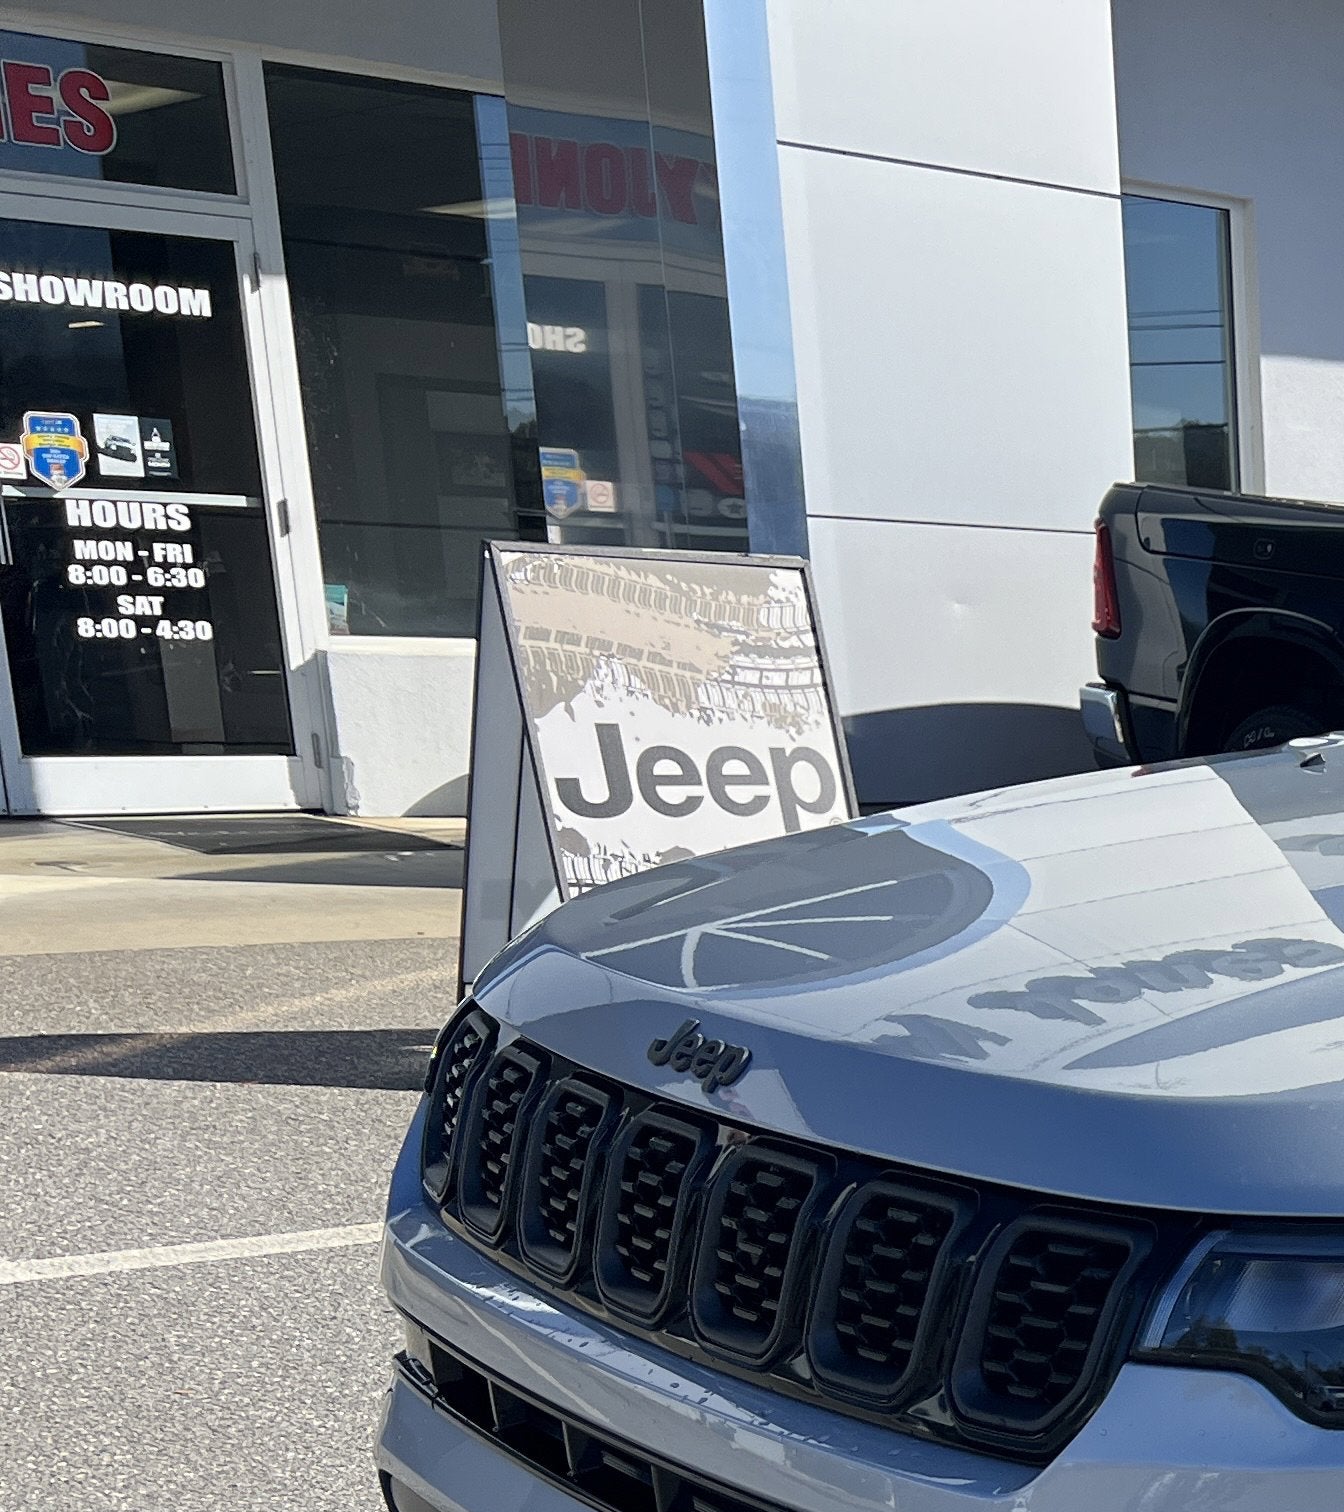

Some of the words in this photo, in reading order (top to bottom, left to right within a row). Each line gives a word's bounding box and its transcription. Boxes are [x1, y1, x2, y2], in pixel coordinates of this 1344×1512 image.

[0, 60, 117, 155] ES
[0, 270, 212, 318] SHOWROOM
[65, 499, 192, 531] HOURS
[73, 540, 134, 562] MON
[152, 543, 194, 564] FRI
[67, 564, 128, 586] 8:00
[146, 567, 206, 588] 6:30
[116, 594, 165, 616] SAT
[76, 617, 137, 639] 8:00
[156, 619, 214, 641] 4:30
[554, 722, 837, 832] Jeep
[647, 1018, 753, 1094] Jeep
